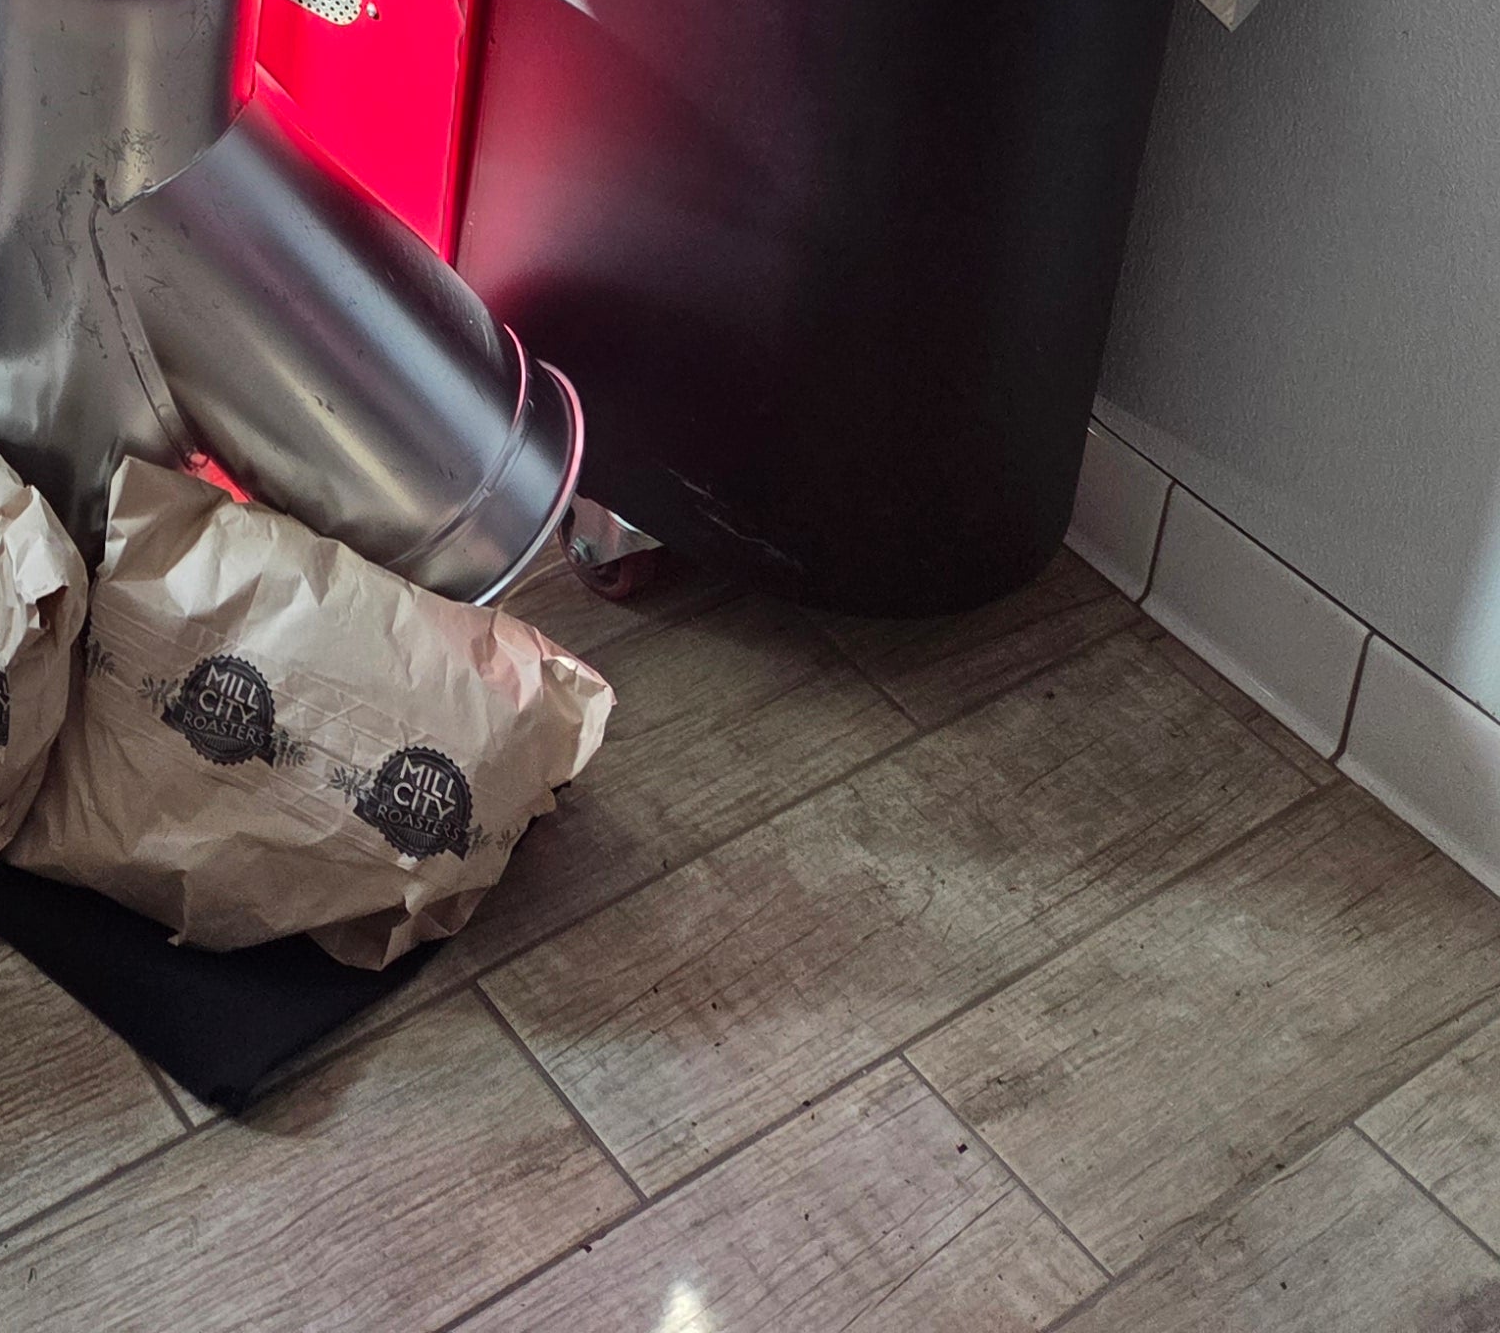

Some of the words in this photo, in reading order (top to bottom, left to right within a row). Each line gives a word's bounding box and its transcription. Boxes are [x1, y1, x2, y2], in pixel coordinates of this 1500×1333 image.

[204, 663, 260, 711] MILL
[198, 689, 258, 725] CITY
[182, 710, 266, 748] ROASTERS
[399, 755, 457, 806] MILL
[393, 781, 456, 821] CITY
[376, 804, 461, 841] ROASTERS
